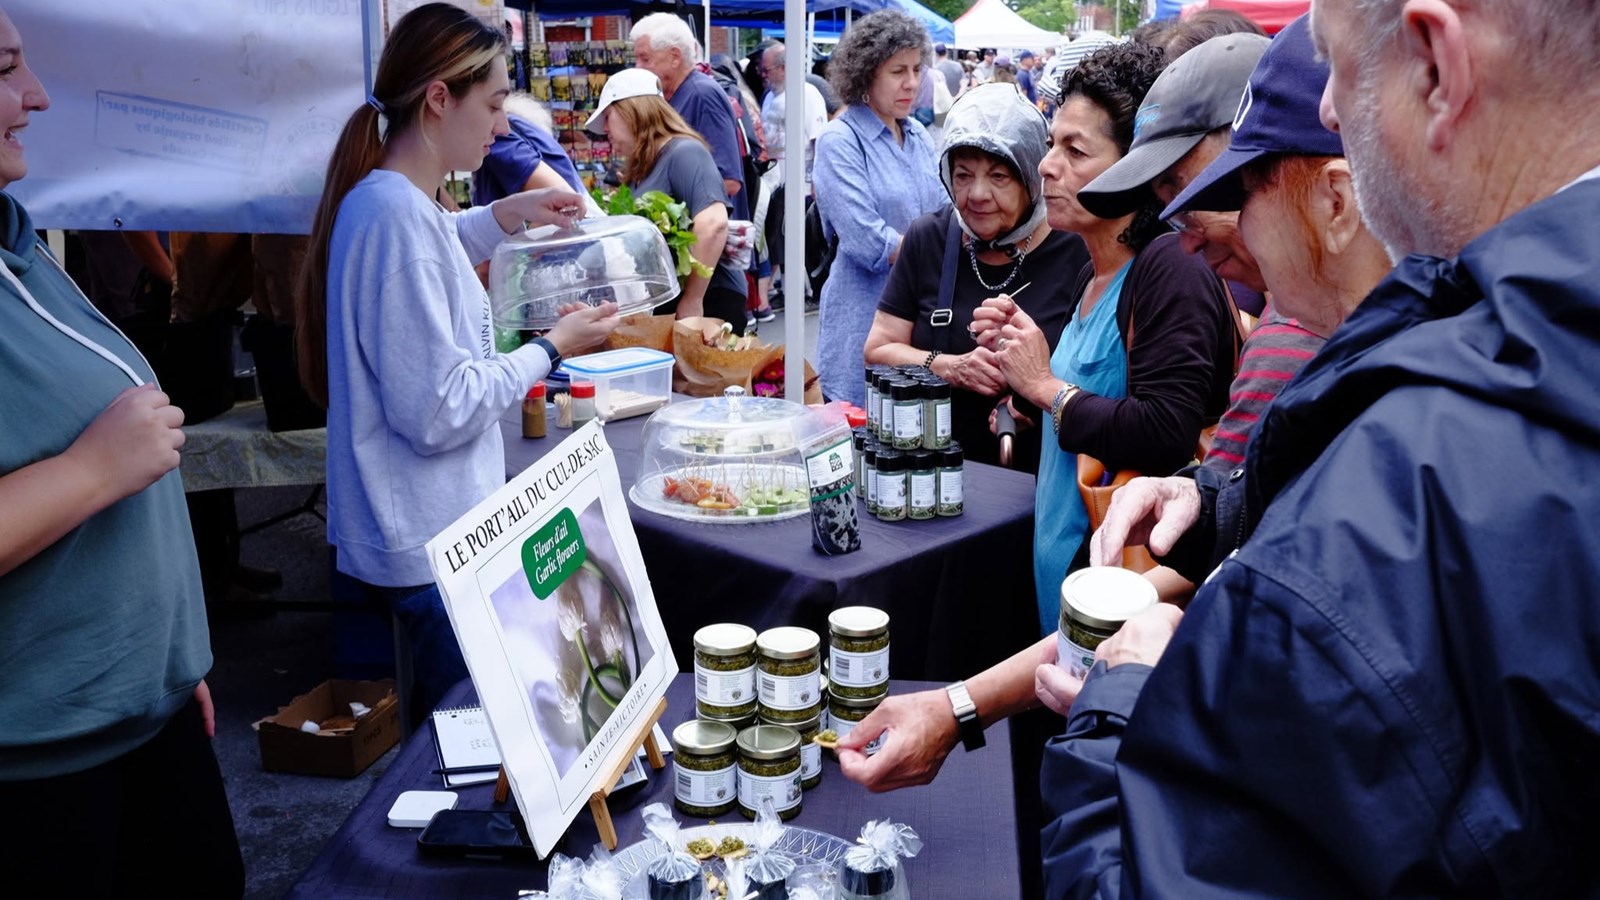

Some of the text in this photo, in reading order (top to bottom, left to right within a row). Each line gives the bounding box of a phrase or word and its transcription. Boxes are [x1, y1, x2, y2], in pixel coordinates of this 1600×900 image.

[481, 324, 491, 359] ALVIN
[445, 433, 604, 574] LE PORT'AIL DU CUL-DE-SAC
[533, 519, 569, 563] Fleurs d'ail
[535, 538, 580, 585] Garlic flowers
[588, 686, 644, 765] SAINTE-VICTOIRE
